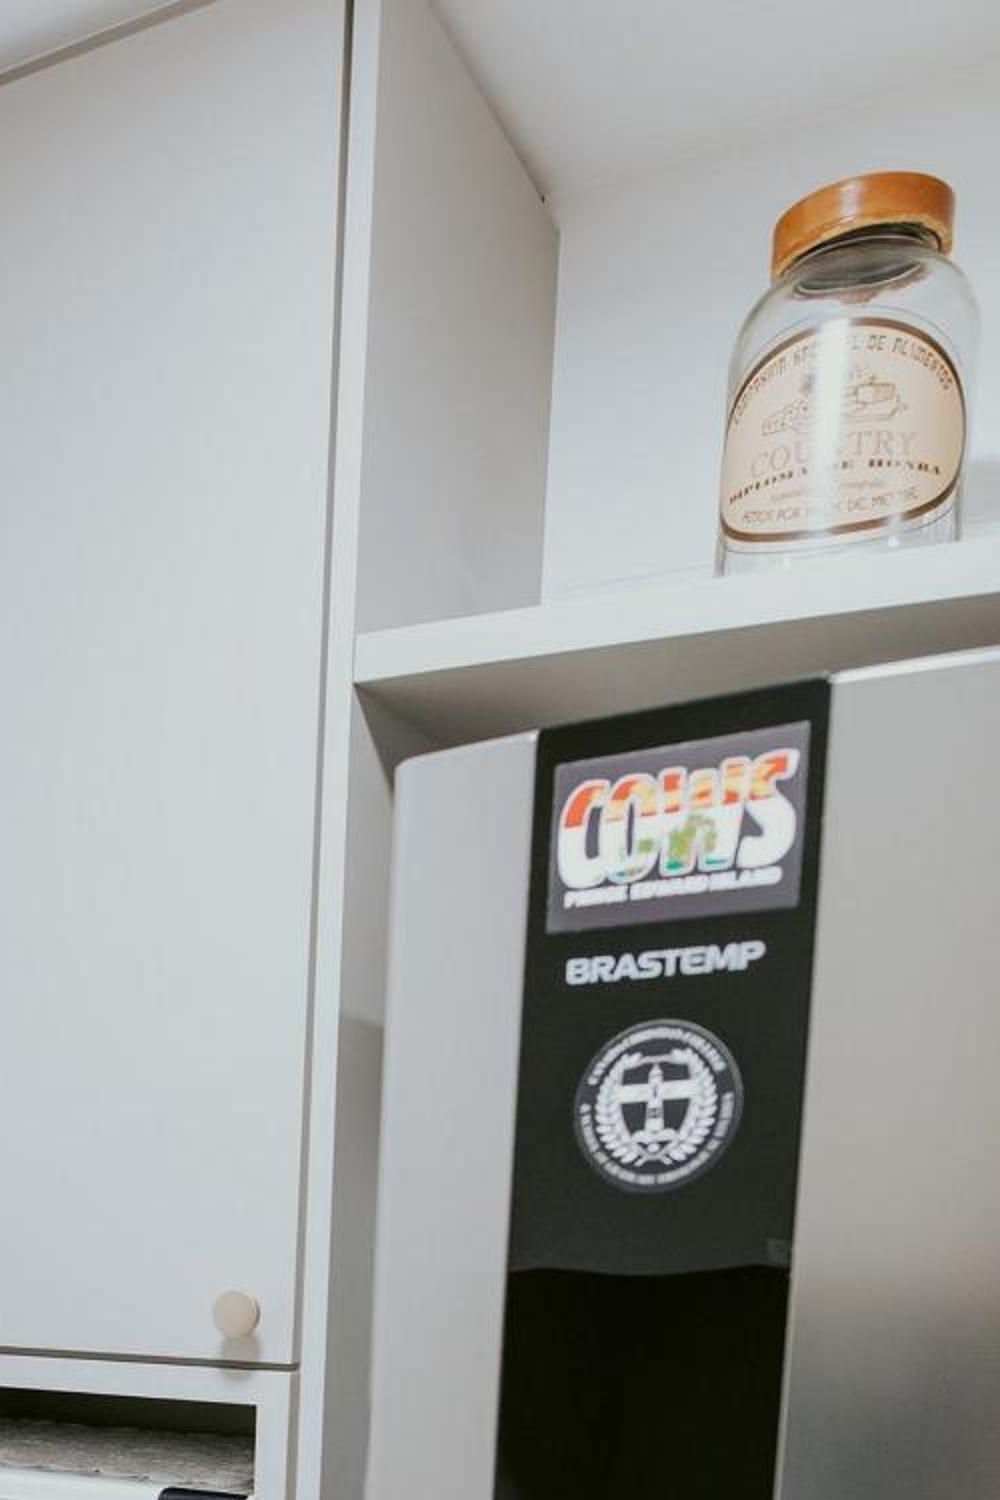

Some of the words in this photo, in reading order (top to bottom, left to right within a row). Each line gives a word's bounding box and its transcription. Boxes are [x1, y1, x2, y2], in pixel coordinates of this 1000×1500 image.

[866, 334, 887, 352] DE
[751, 431, 919, 478] COUTRY
[558, 748, 799, 889] COWS
[565, 939, 767, 986] BRASTEMP
